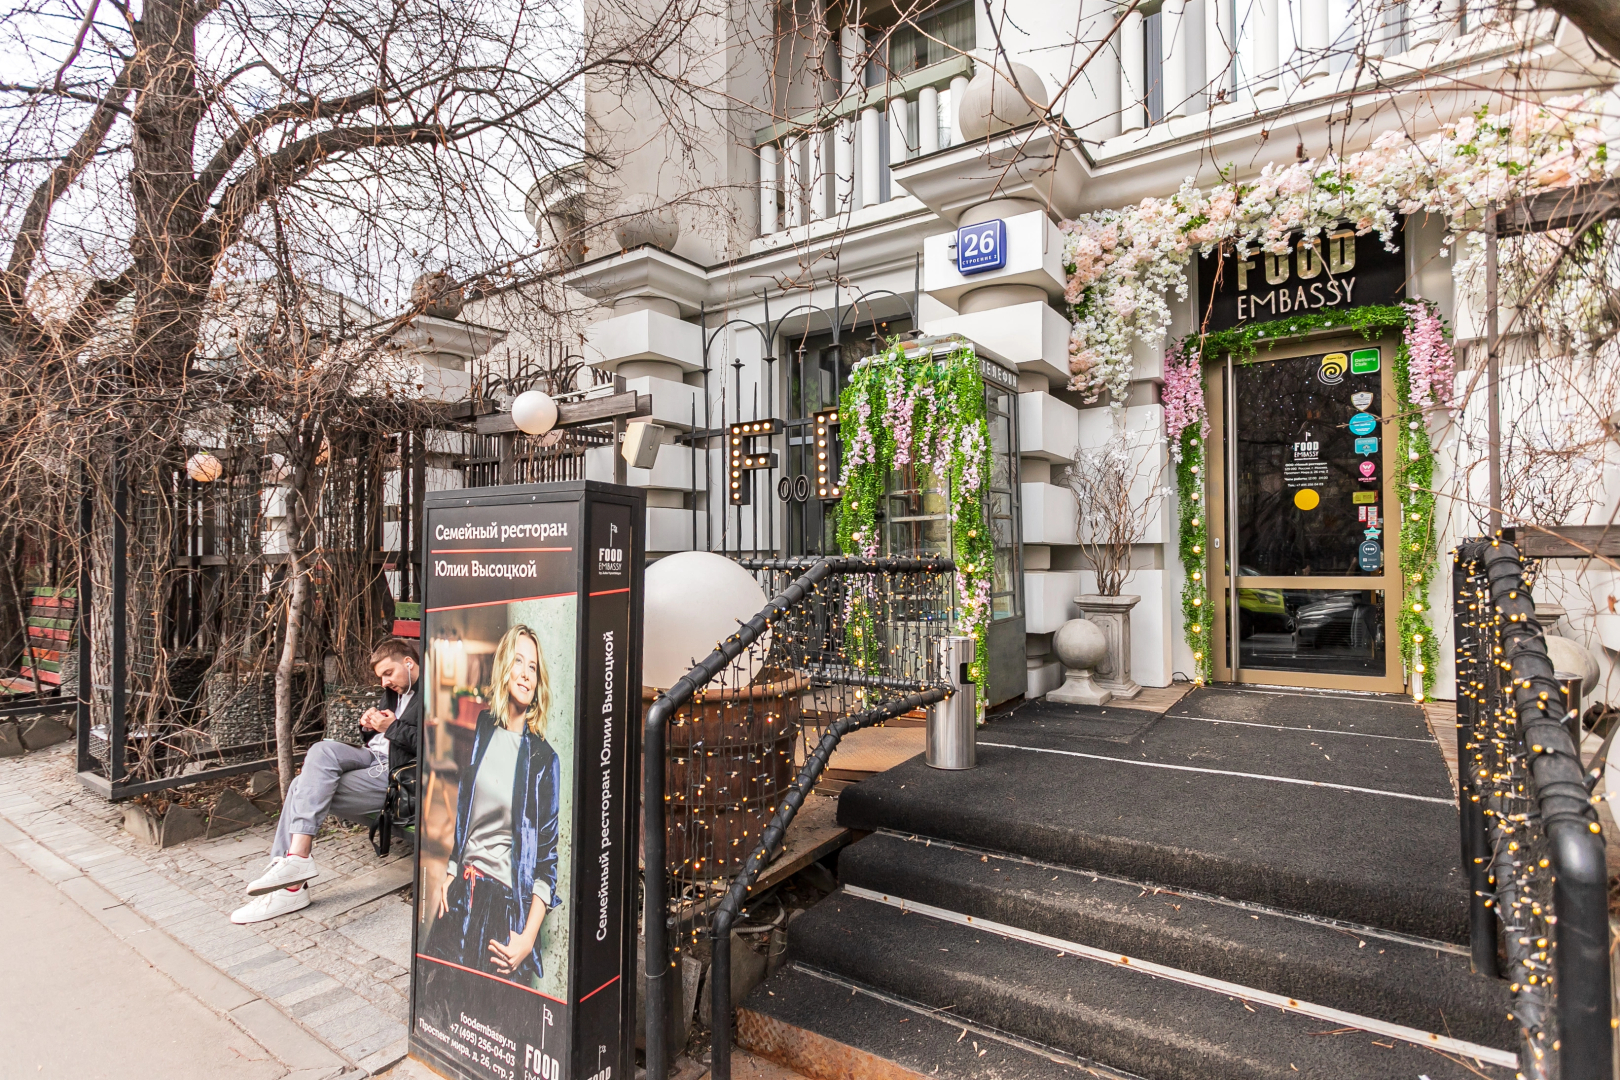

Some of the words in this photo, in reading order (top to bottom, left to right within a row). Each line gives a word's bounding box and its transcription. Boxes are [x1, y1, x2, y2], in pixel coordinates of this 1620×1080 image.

[962, 255, 992, 266] СТРОЕНИЕ
[964, 230, 994, 257] 26
[1237, 229, 1356, 291] FOOD
[1237, 276, 1356, 320] EMBASSY
[981, 359, 1017, 388] ТЕЛЕФОН
[1294, 441, 1319, 452] FOOD
[1294, 450, 1319, 458] EMBASSY
[435, 522, 498, 541] Семейный
[501, 522, 568, 542] ресторан
[435, 560, 469, 578] Юлии
[471, 560, 537, 579] Высоцкой
[599, 548, 622, 562] FOOD
[599, 562, 622, 571] EMBASSY
[602, 630, 615, 714] Высоцкой
[600, 717, 612, 767] Юлии
[601, 769, 612, 849] ресторан
[596, 851, 609, 941] Семейный
[419, 1017, 450, 1044] Проспект
[450, 1038, 471, 1058] мира,
[472, 1051, 479, 1062] д.
[480, 1054, 491, 1070] 26,
[492, 1063, 508, 1080] стр.
[508, 1070, 515, 1080] 2
[450, 1023, 459, 1034] +7
[459, 1026, 477, 1046] (495)
[478, 1036, 515, 1067] 256-04-03
[460, 1012, 516, 1051] foodembassy.ru
[524, 1043, 560, 1080] FOOD
